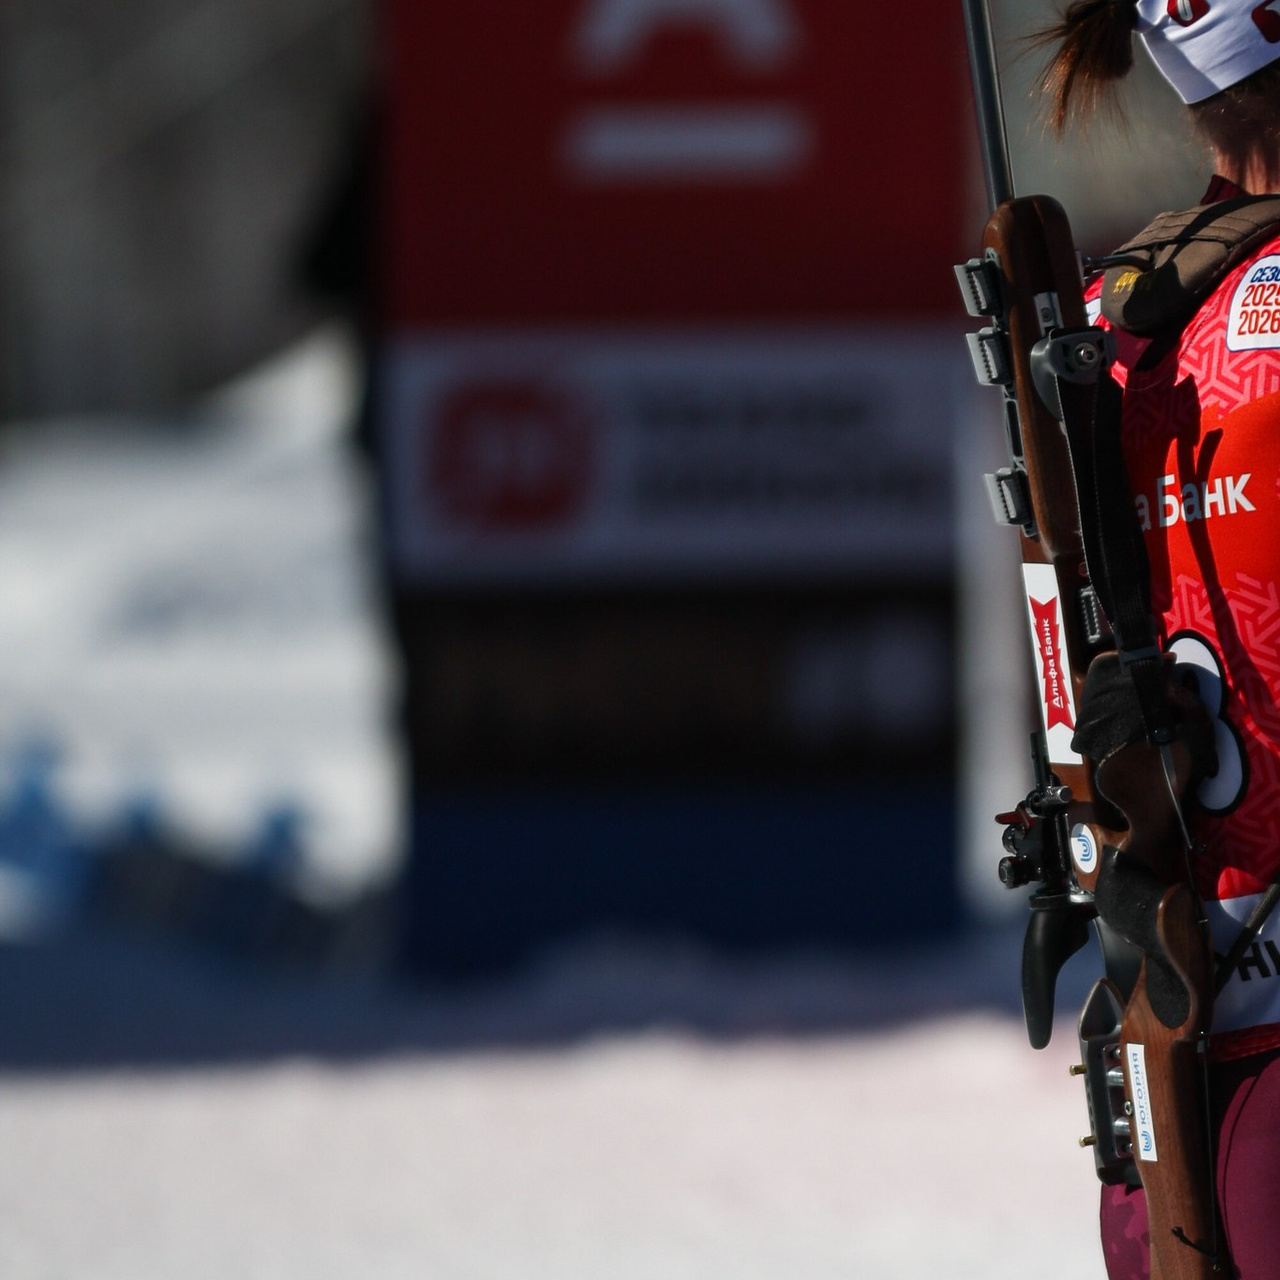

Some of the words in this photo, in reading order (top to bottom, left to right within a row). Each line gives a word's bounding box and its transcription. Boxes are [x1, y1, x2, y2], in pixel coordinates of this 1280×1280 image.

[1157, 472, 1257, 529] Банк
[1043, 617, 1054, 656] Банк
[1048, 659, 1063, 708] Альфа
[1132, 1052, 1147, 1125] ЮГОРИЯ
